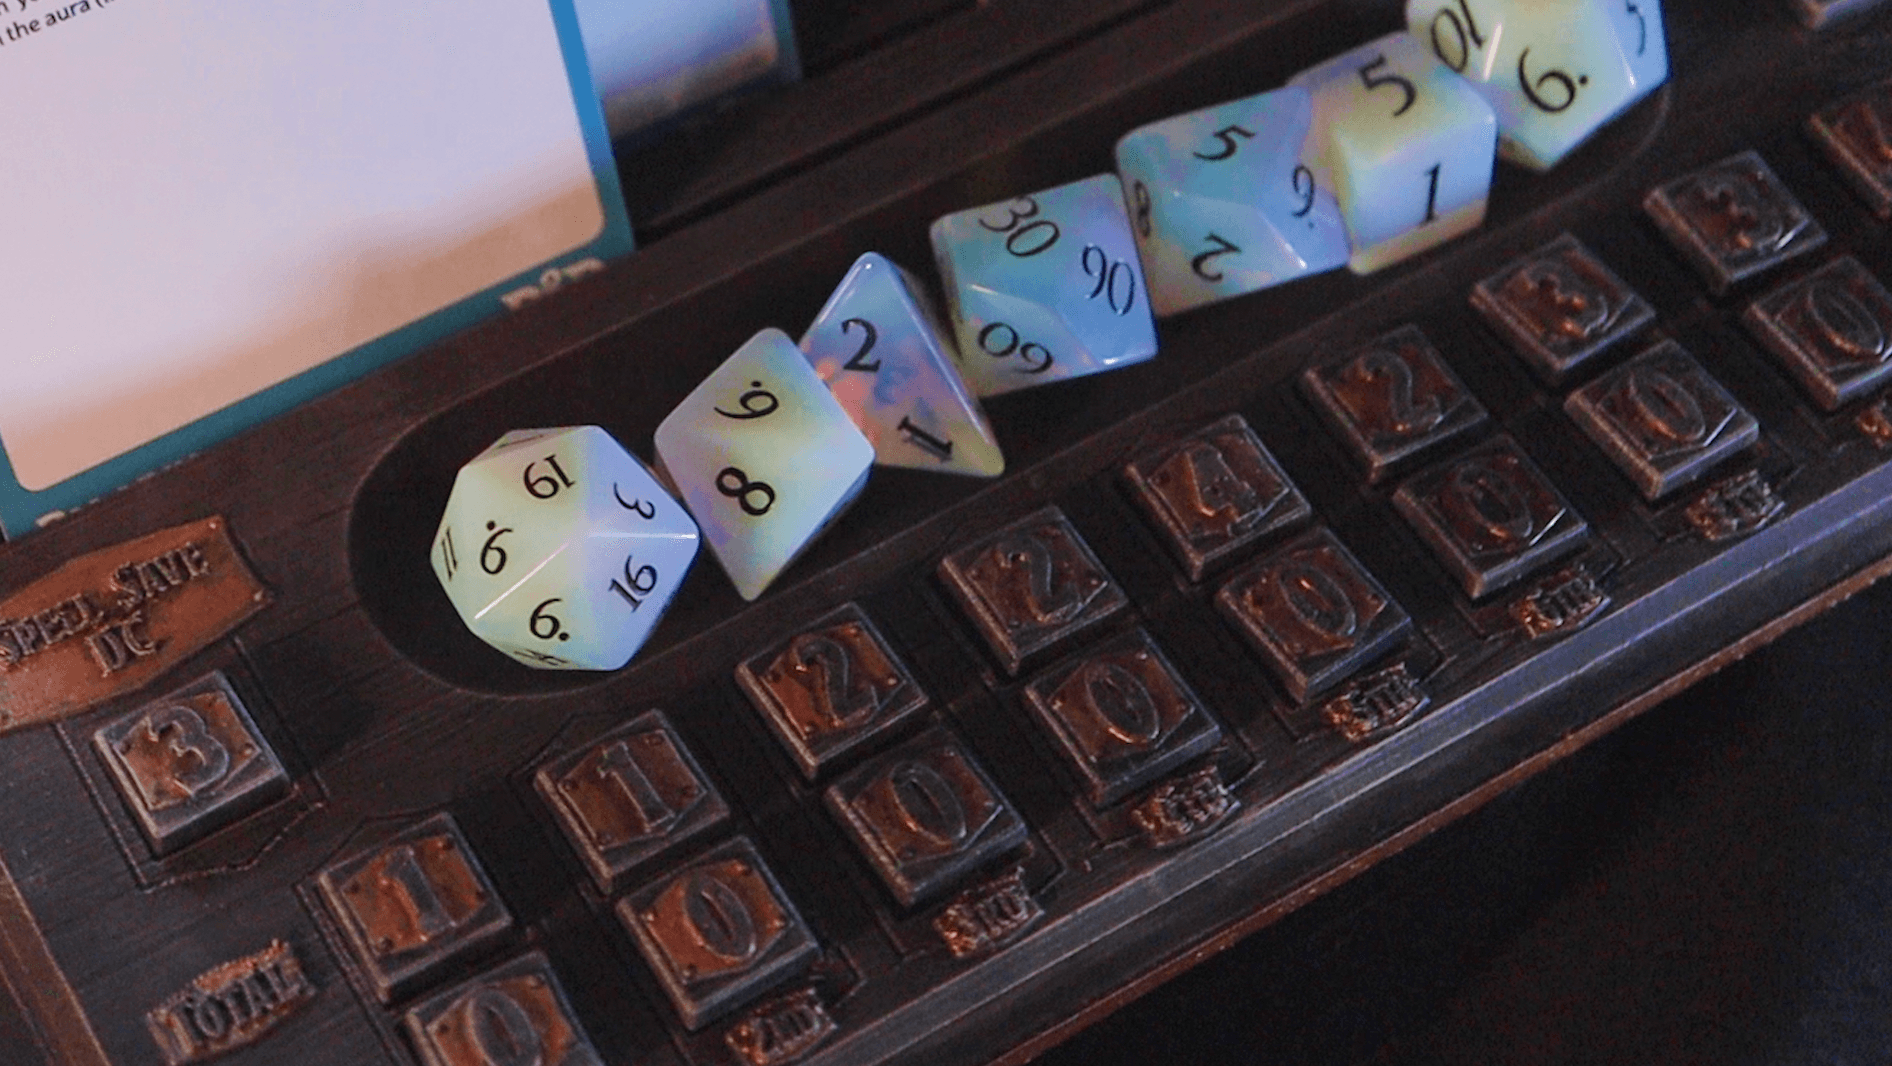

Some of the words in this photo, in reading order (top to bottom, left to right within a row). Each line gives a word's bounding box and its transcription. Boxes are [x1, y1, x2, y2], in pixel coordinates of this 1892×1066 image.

[6, 19, 41, 42] the
[45, 0, 91, 27] aura
[1358, 55, 1417, 118] 5
[1193, 124, 1256, 161] 5
[978, 195, 1060, 258] 30
[1421, 162, 1442, 226] 1
[1081, 243, 1136, 316] 90
[1191, 231, 1242, 283] 2
[1520, 260, 1609, 338] 3
[841, 317, 881, 372] 2
[1357, 350, 1443, 432] 2
[1628, 368, 1707, 442] 0
[898, 415, 953, 462] 1
[613, 481, 655, 520] 3
[715, 467, 777, 517] 8
[1184, 441, 1262, 524] 4
[1456, 463, 1533, 538] 0
[109, 541, 210, 607] SAVE
[608, 554, 659, 623] 16
[996, 535, 1083, 622] 2
[1278, 560, 1357, 638] 0
[85, 611, 155, 678] DC
[792, 637, 881, 728] 2
[1083, 660, 1160, 745] 0
[146, 704, 230, 797] 3
[597, 740, 676, 834] 1
[888, 759, 968, 847] 0
[376, 846, 457, 940] 1
[683, 872, 757, 962] 0
[157, 957, 303, 1056] TOTAL
